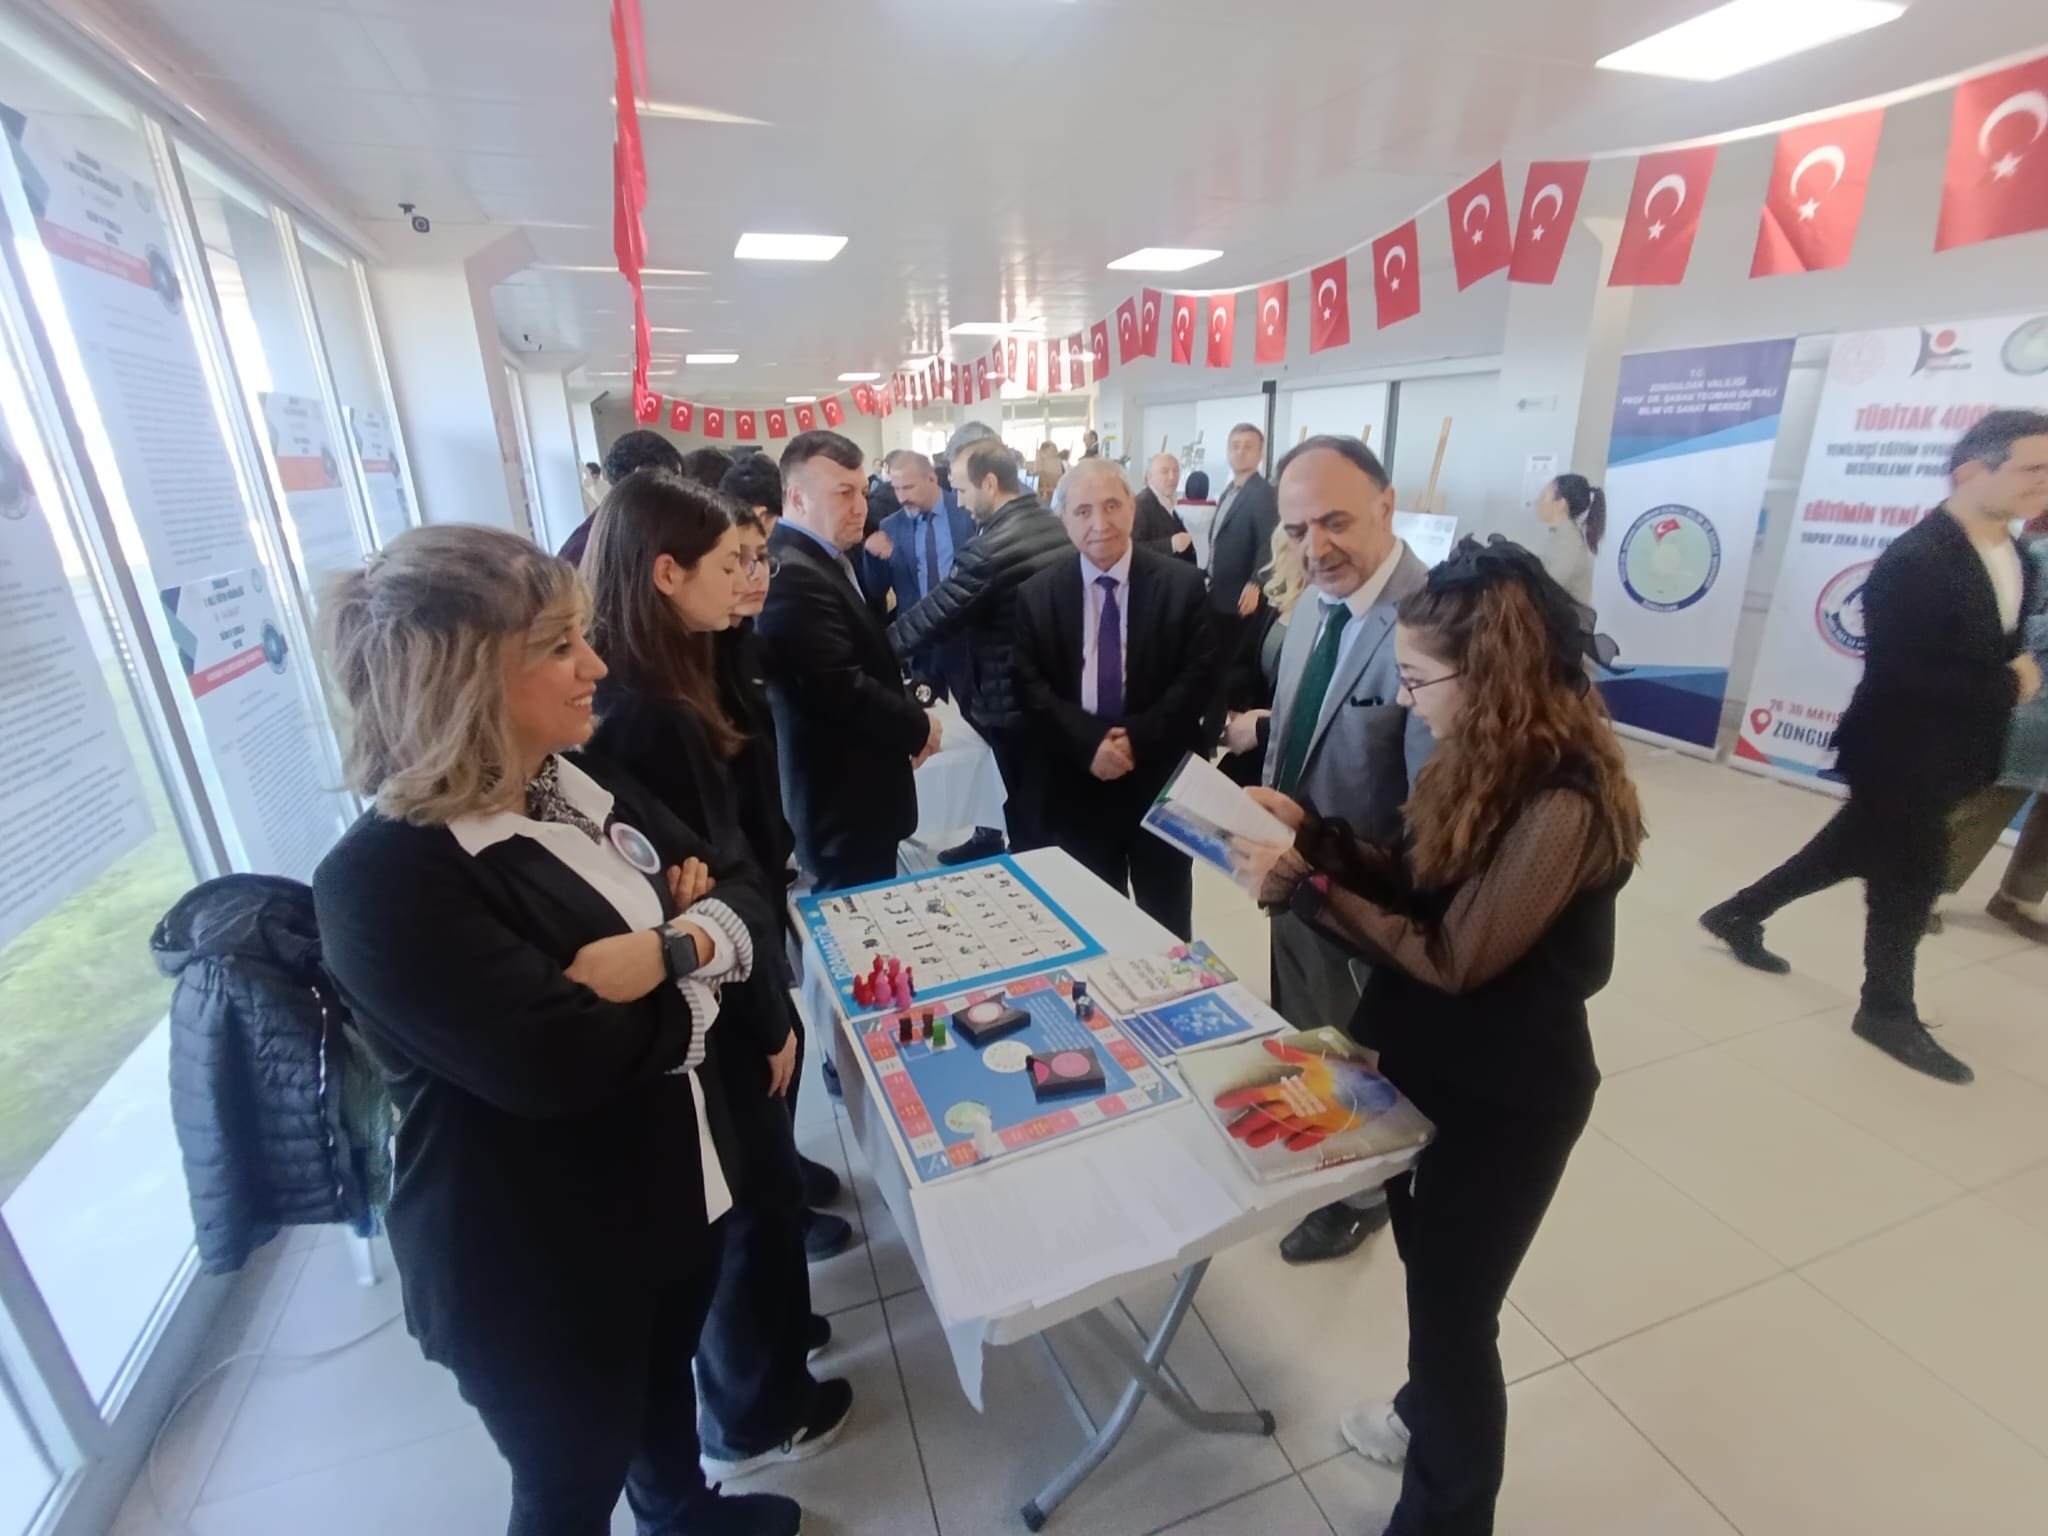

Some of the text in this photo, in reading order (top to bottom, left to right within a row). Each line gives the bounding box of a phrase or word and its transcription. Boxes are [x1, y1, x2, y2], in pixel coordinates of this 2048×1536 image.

[1854, 403, 1939, 432] TÜBİTAK
[1803, 499, 1875, 524] EĞİTİMİN
[1879, 502, 1921, 527] YENİ
[1773, 720, 1839, 752] ZONGUL
